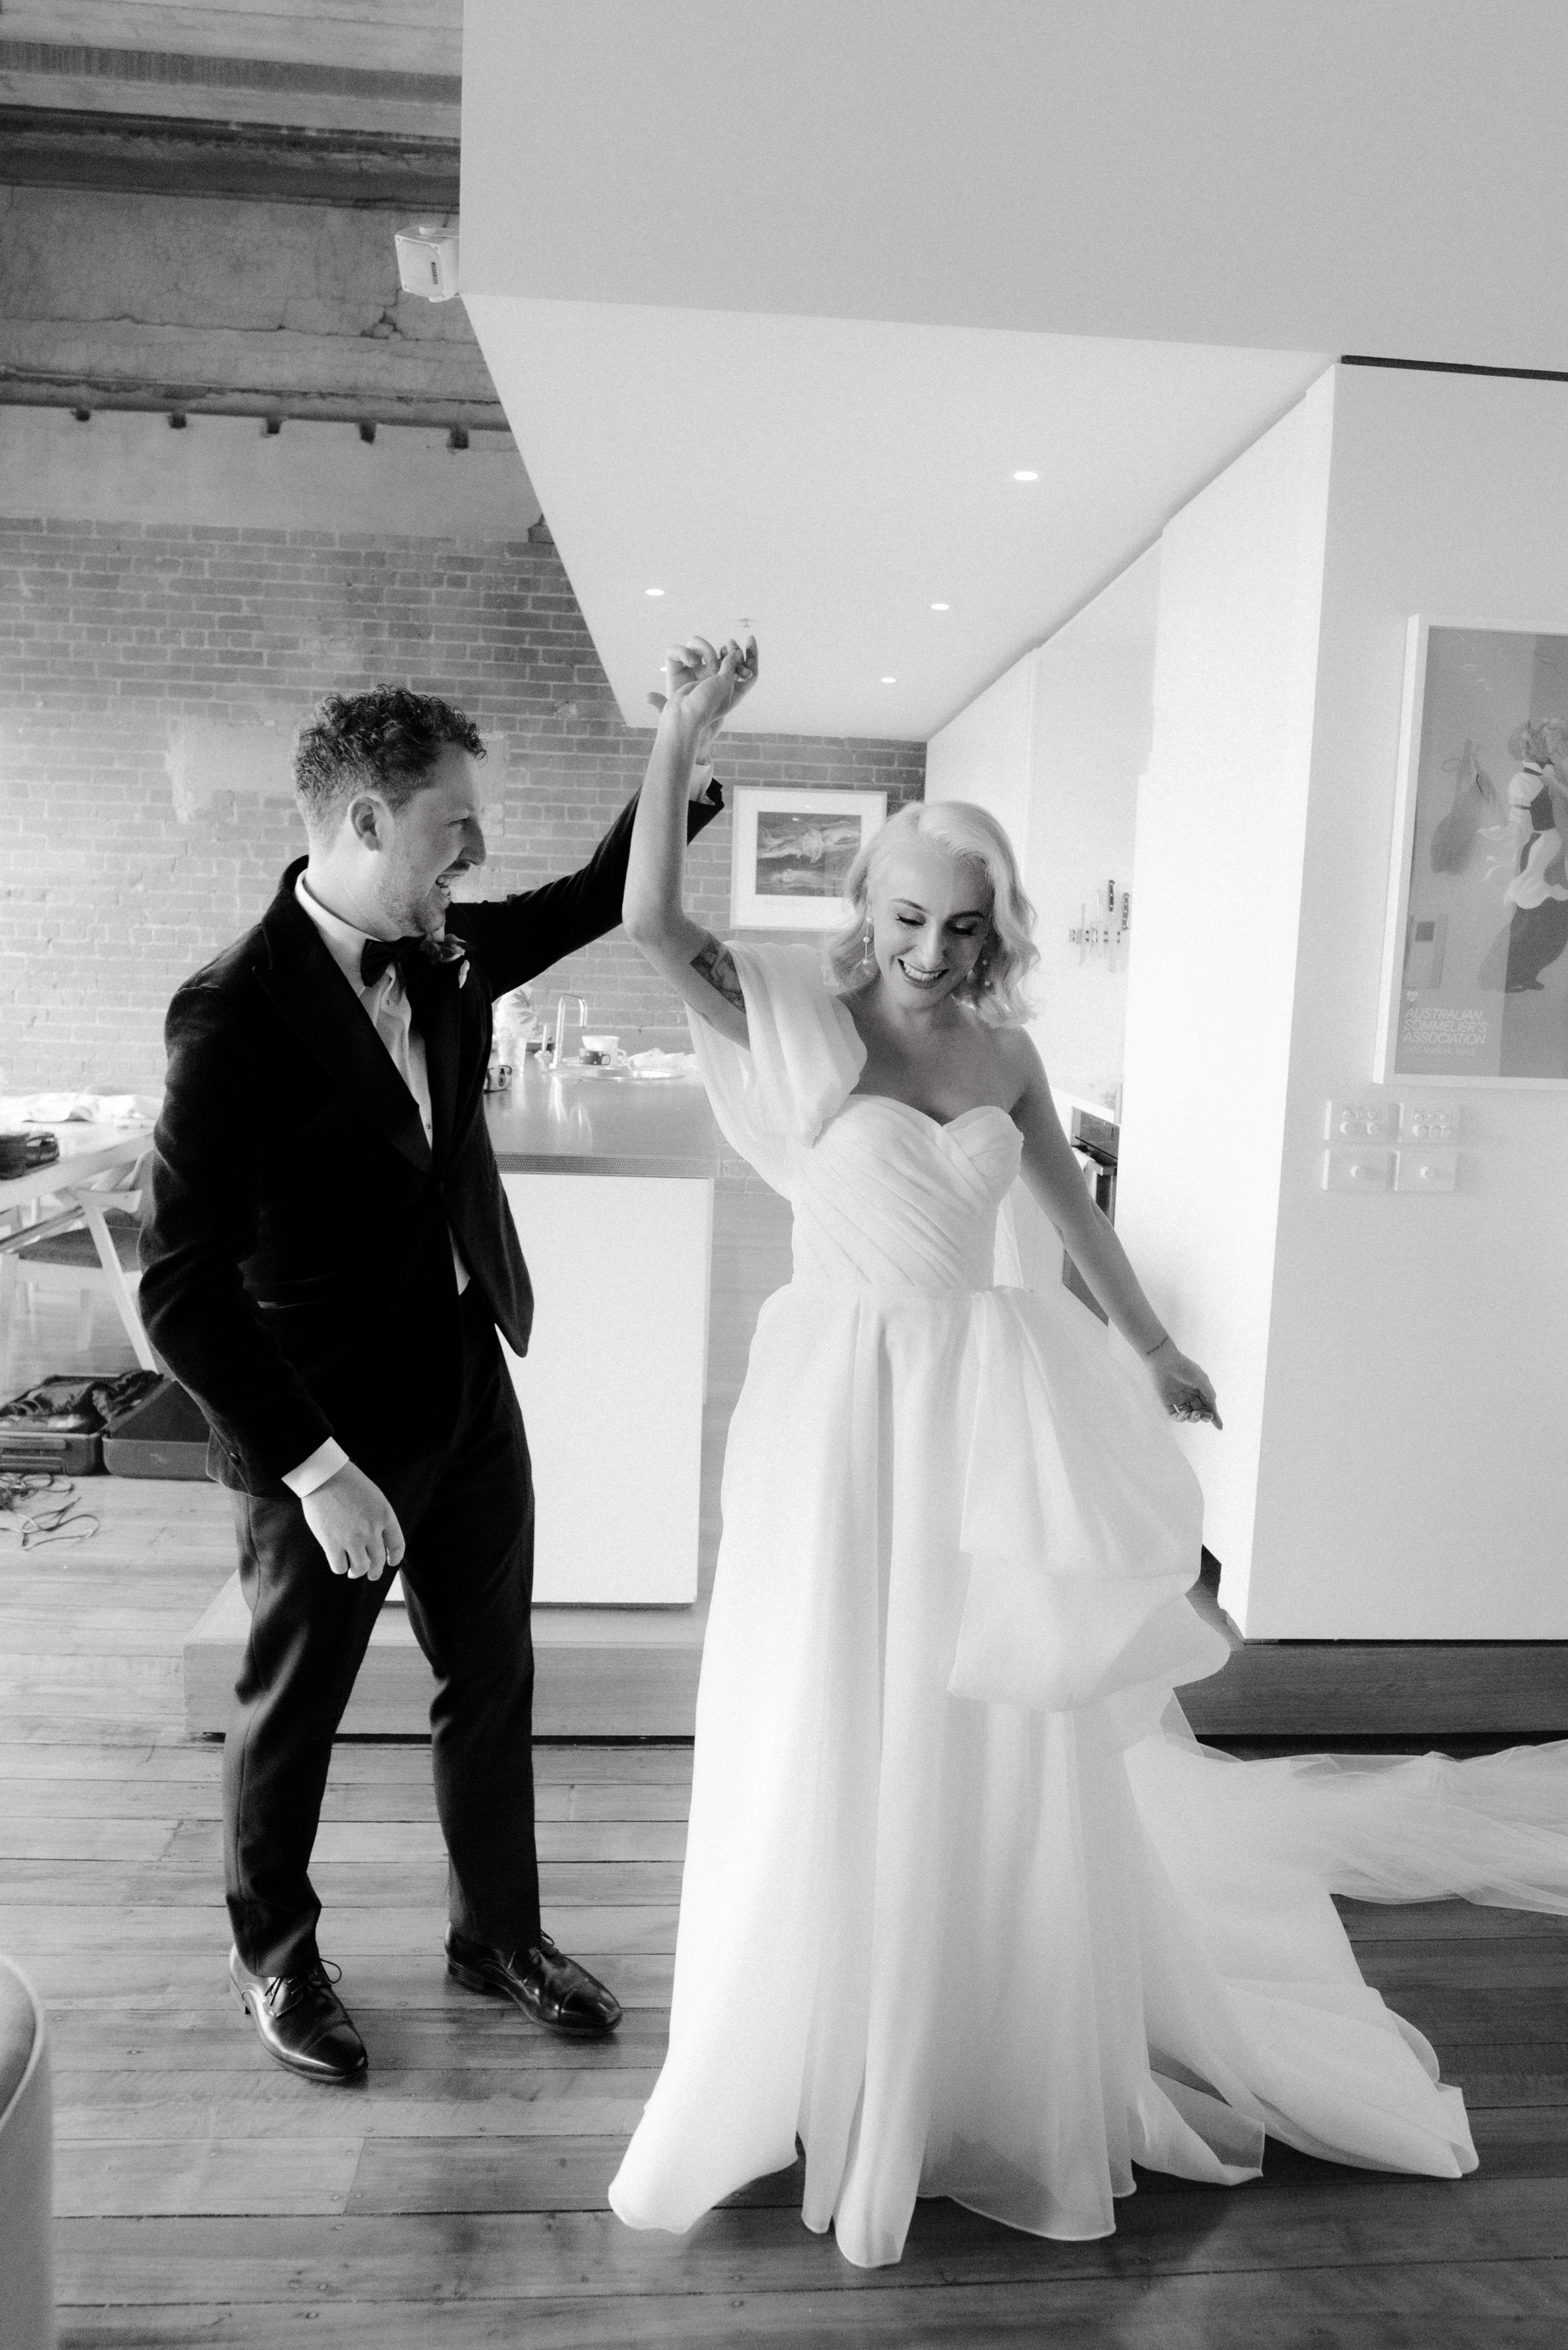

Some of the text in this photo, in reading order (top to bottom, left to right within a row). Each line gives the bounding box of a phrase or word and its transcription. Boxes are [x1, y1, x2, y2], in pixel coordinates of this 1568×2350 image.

[1405, 1008, 1482, 1020] AUSTRALIAN
[1403, 1019, 1488, 1033] SOMMELIER'S
[1403, 1032, 1486, 1044] ASSOCIATION
